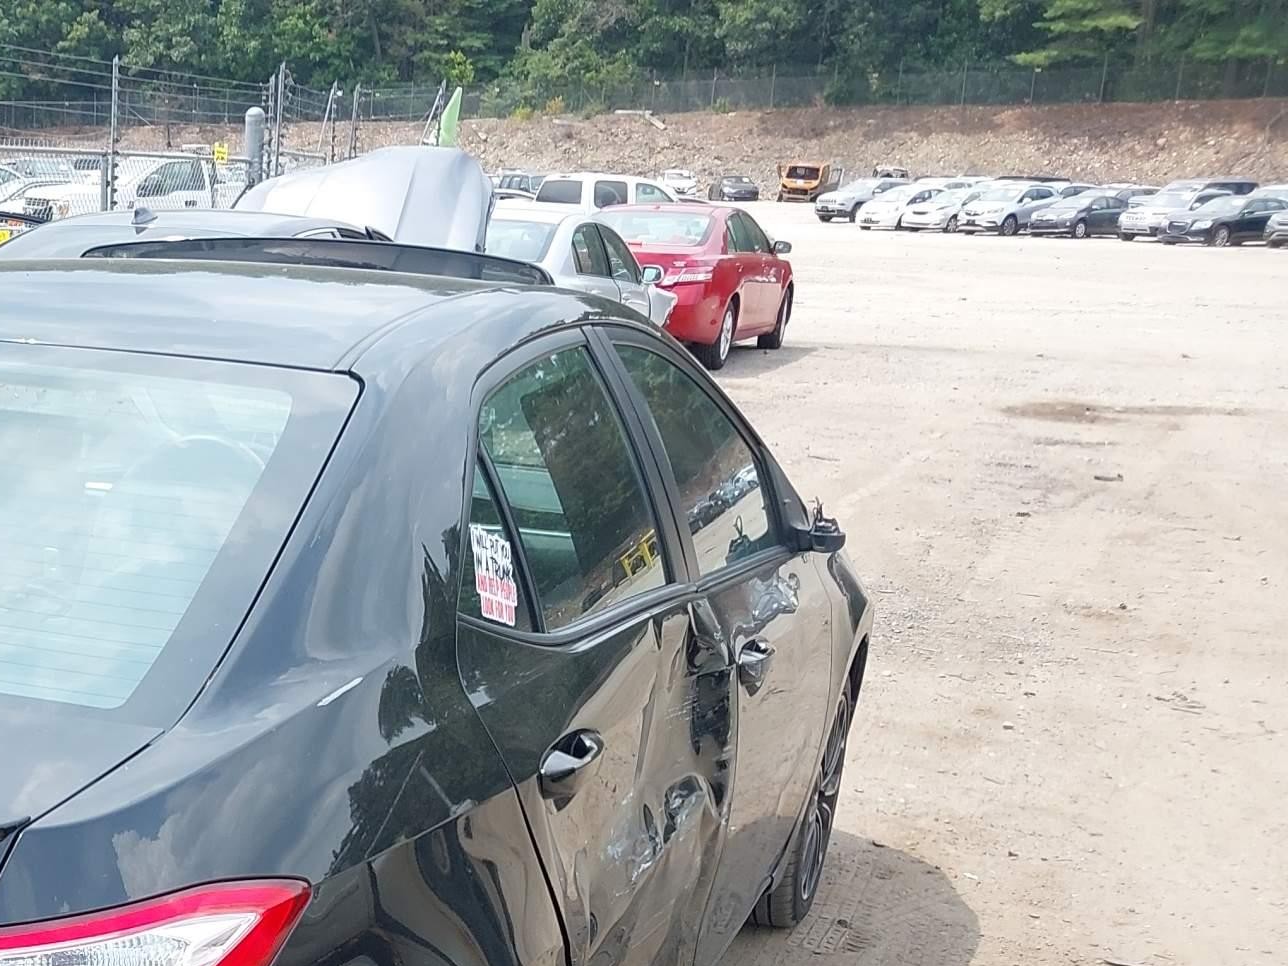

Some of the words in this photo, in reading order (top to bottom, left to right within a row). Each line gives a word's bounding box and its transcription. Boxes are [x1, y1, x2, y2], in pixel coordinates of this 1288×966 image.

[490, 556, 512, 581] TRUNK
[482, 595, 494, 617] LOOK
[495, 599, 505, 620] FOR
